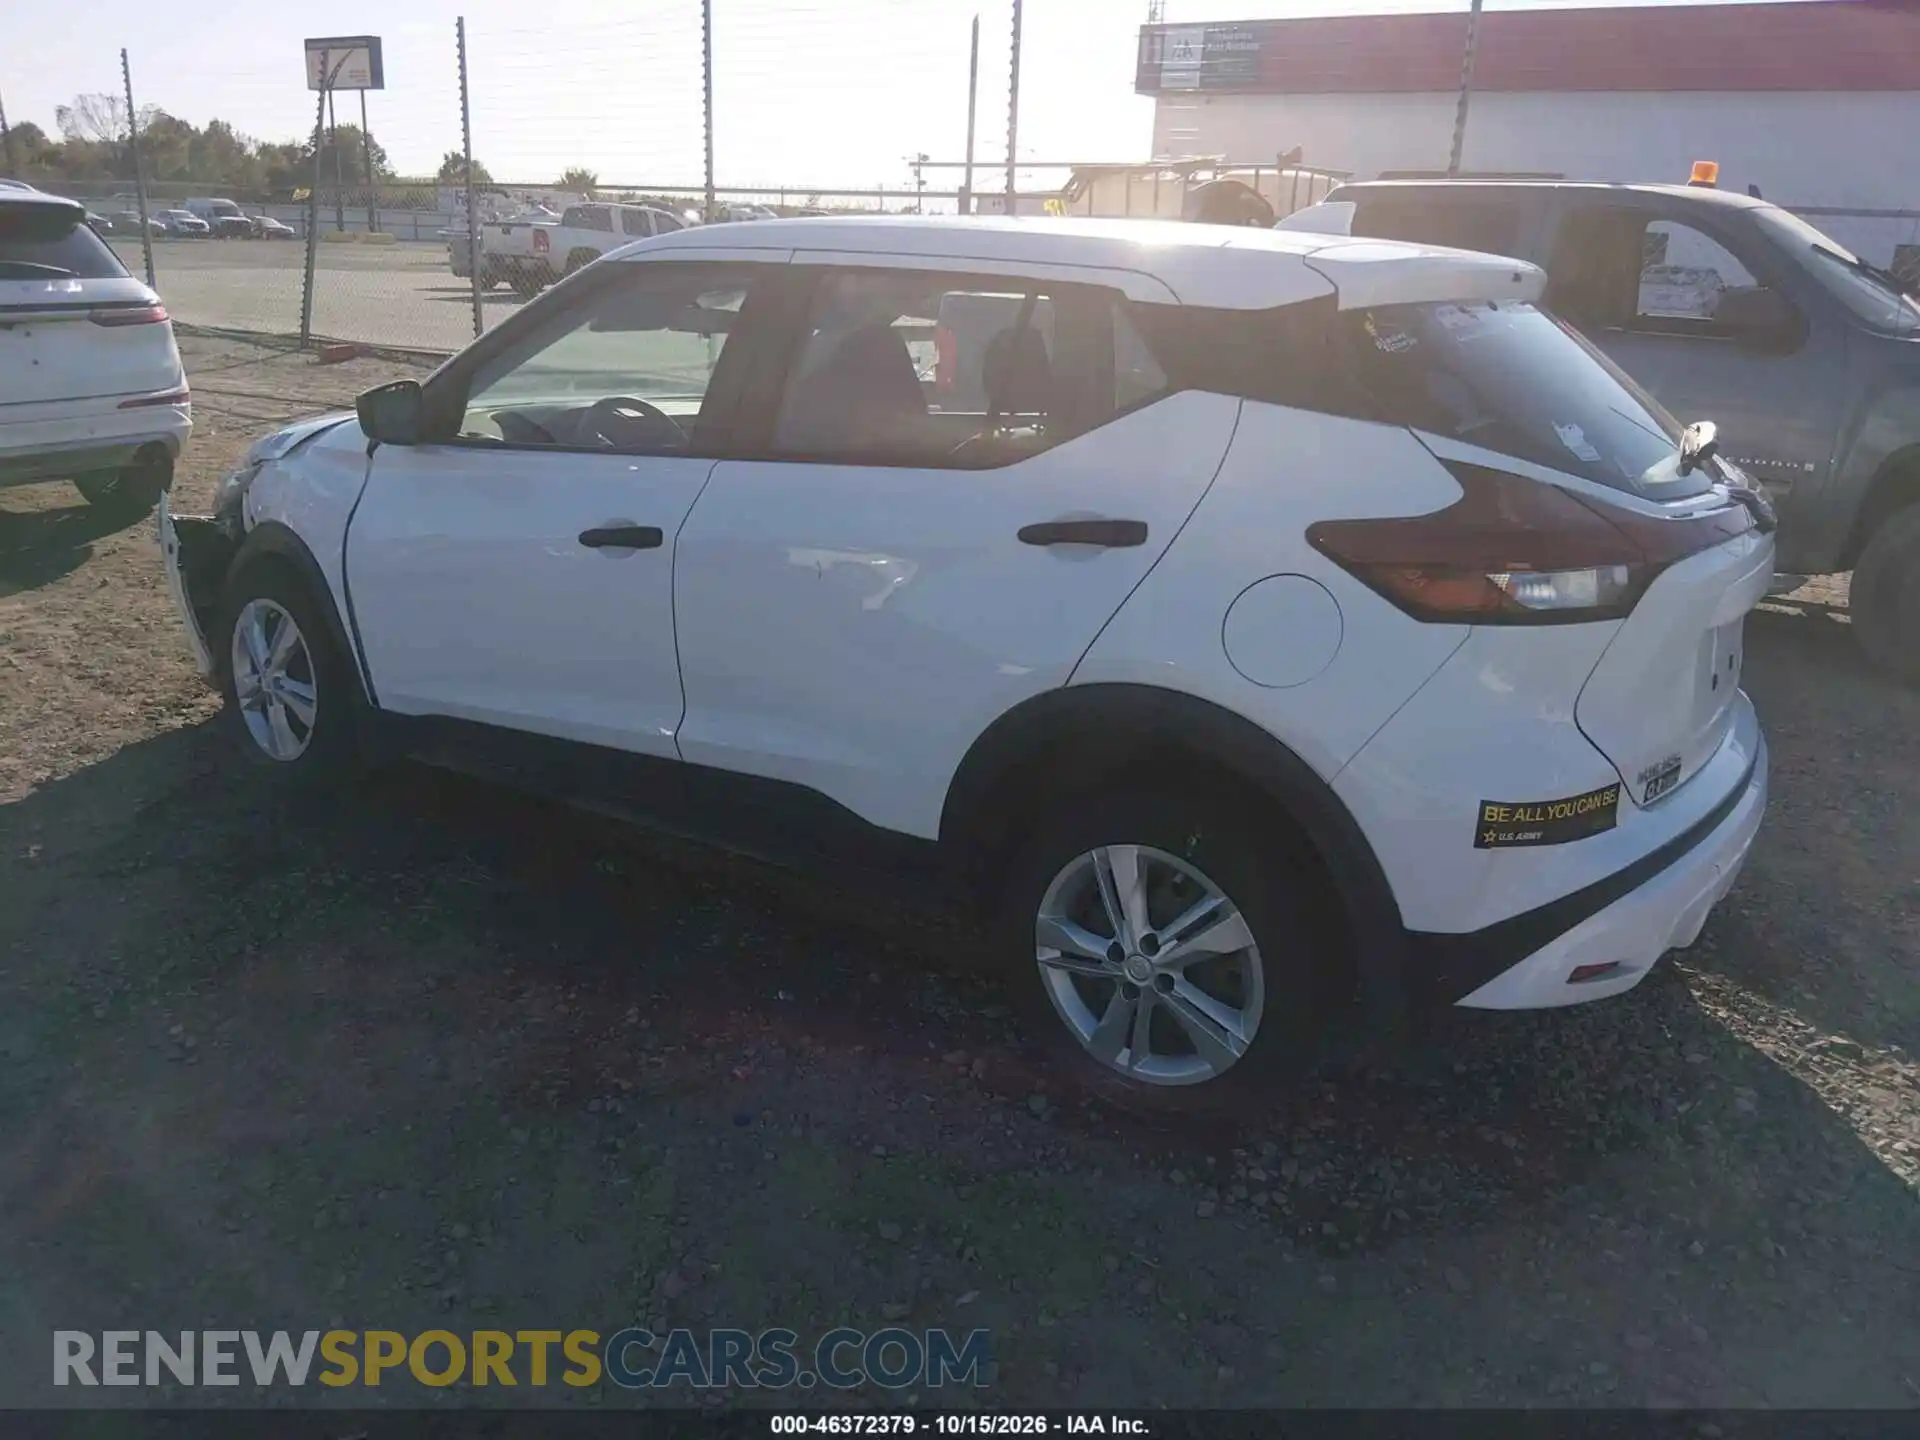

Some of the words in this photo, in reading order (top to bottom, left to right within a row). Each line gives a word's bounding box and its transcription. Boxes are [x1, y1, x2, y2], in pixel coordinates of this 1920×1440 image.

[1484, 805, 1512, 822] BE
[1513, 807, 1545, 821] ALL
[1547, 801, 1577, 820] YOU
[1578, 794, 1602, 814] CAN
[1603, 788, 1618, 806] BE
[1515, 831, 1543, 841] ARMY
